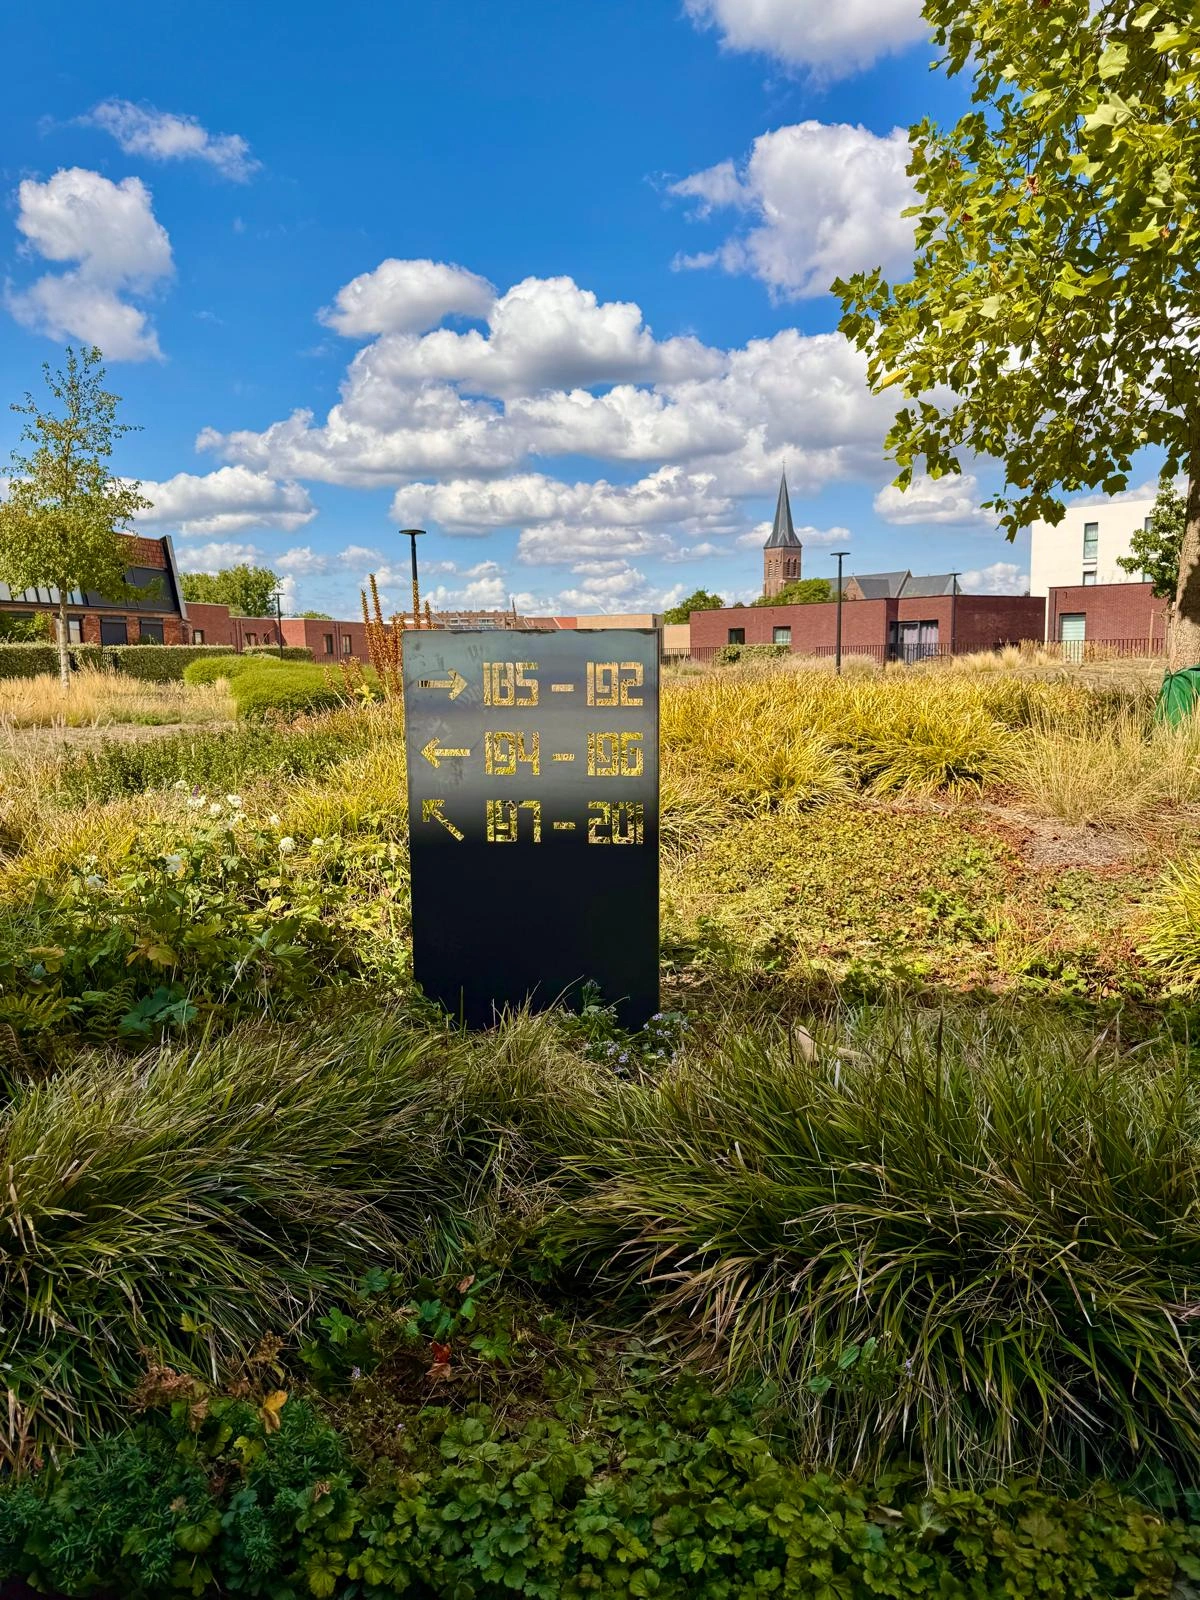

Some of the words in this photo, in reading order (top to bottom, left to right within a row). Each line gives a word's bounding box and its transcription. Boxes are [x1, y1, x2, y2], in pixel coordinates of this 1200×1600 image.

[483, 662, 539, 707] 185
[586, 661, 644, 707] 192
[485, 731, 541, 777] 194
[587, 731, 644, 777] 196
[486, 799, 542, 844] 197
[587, 800, 644, 845] 201
